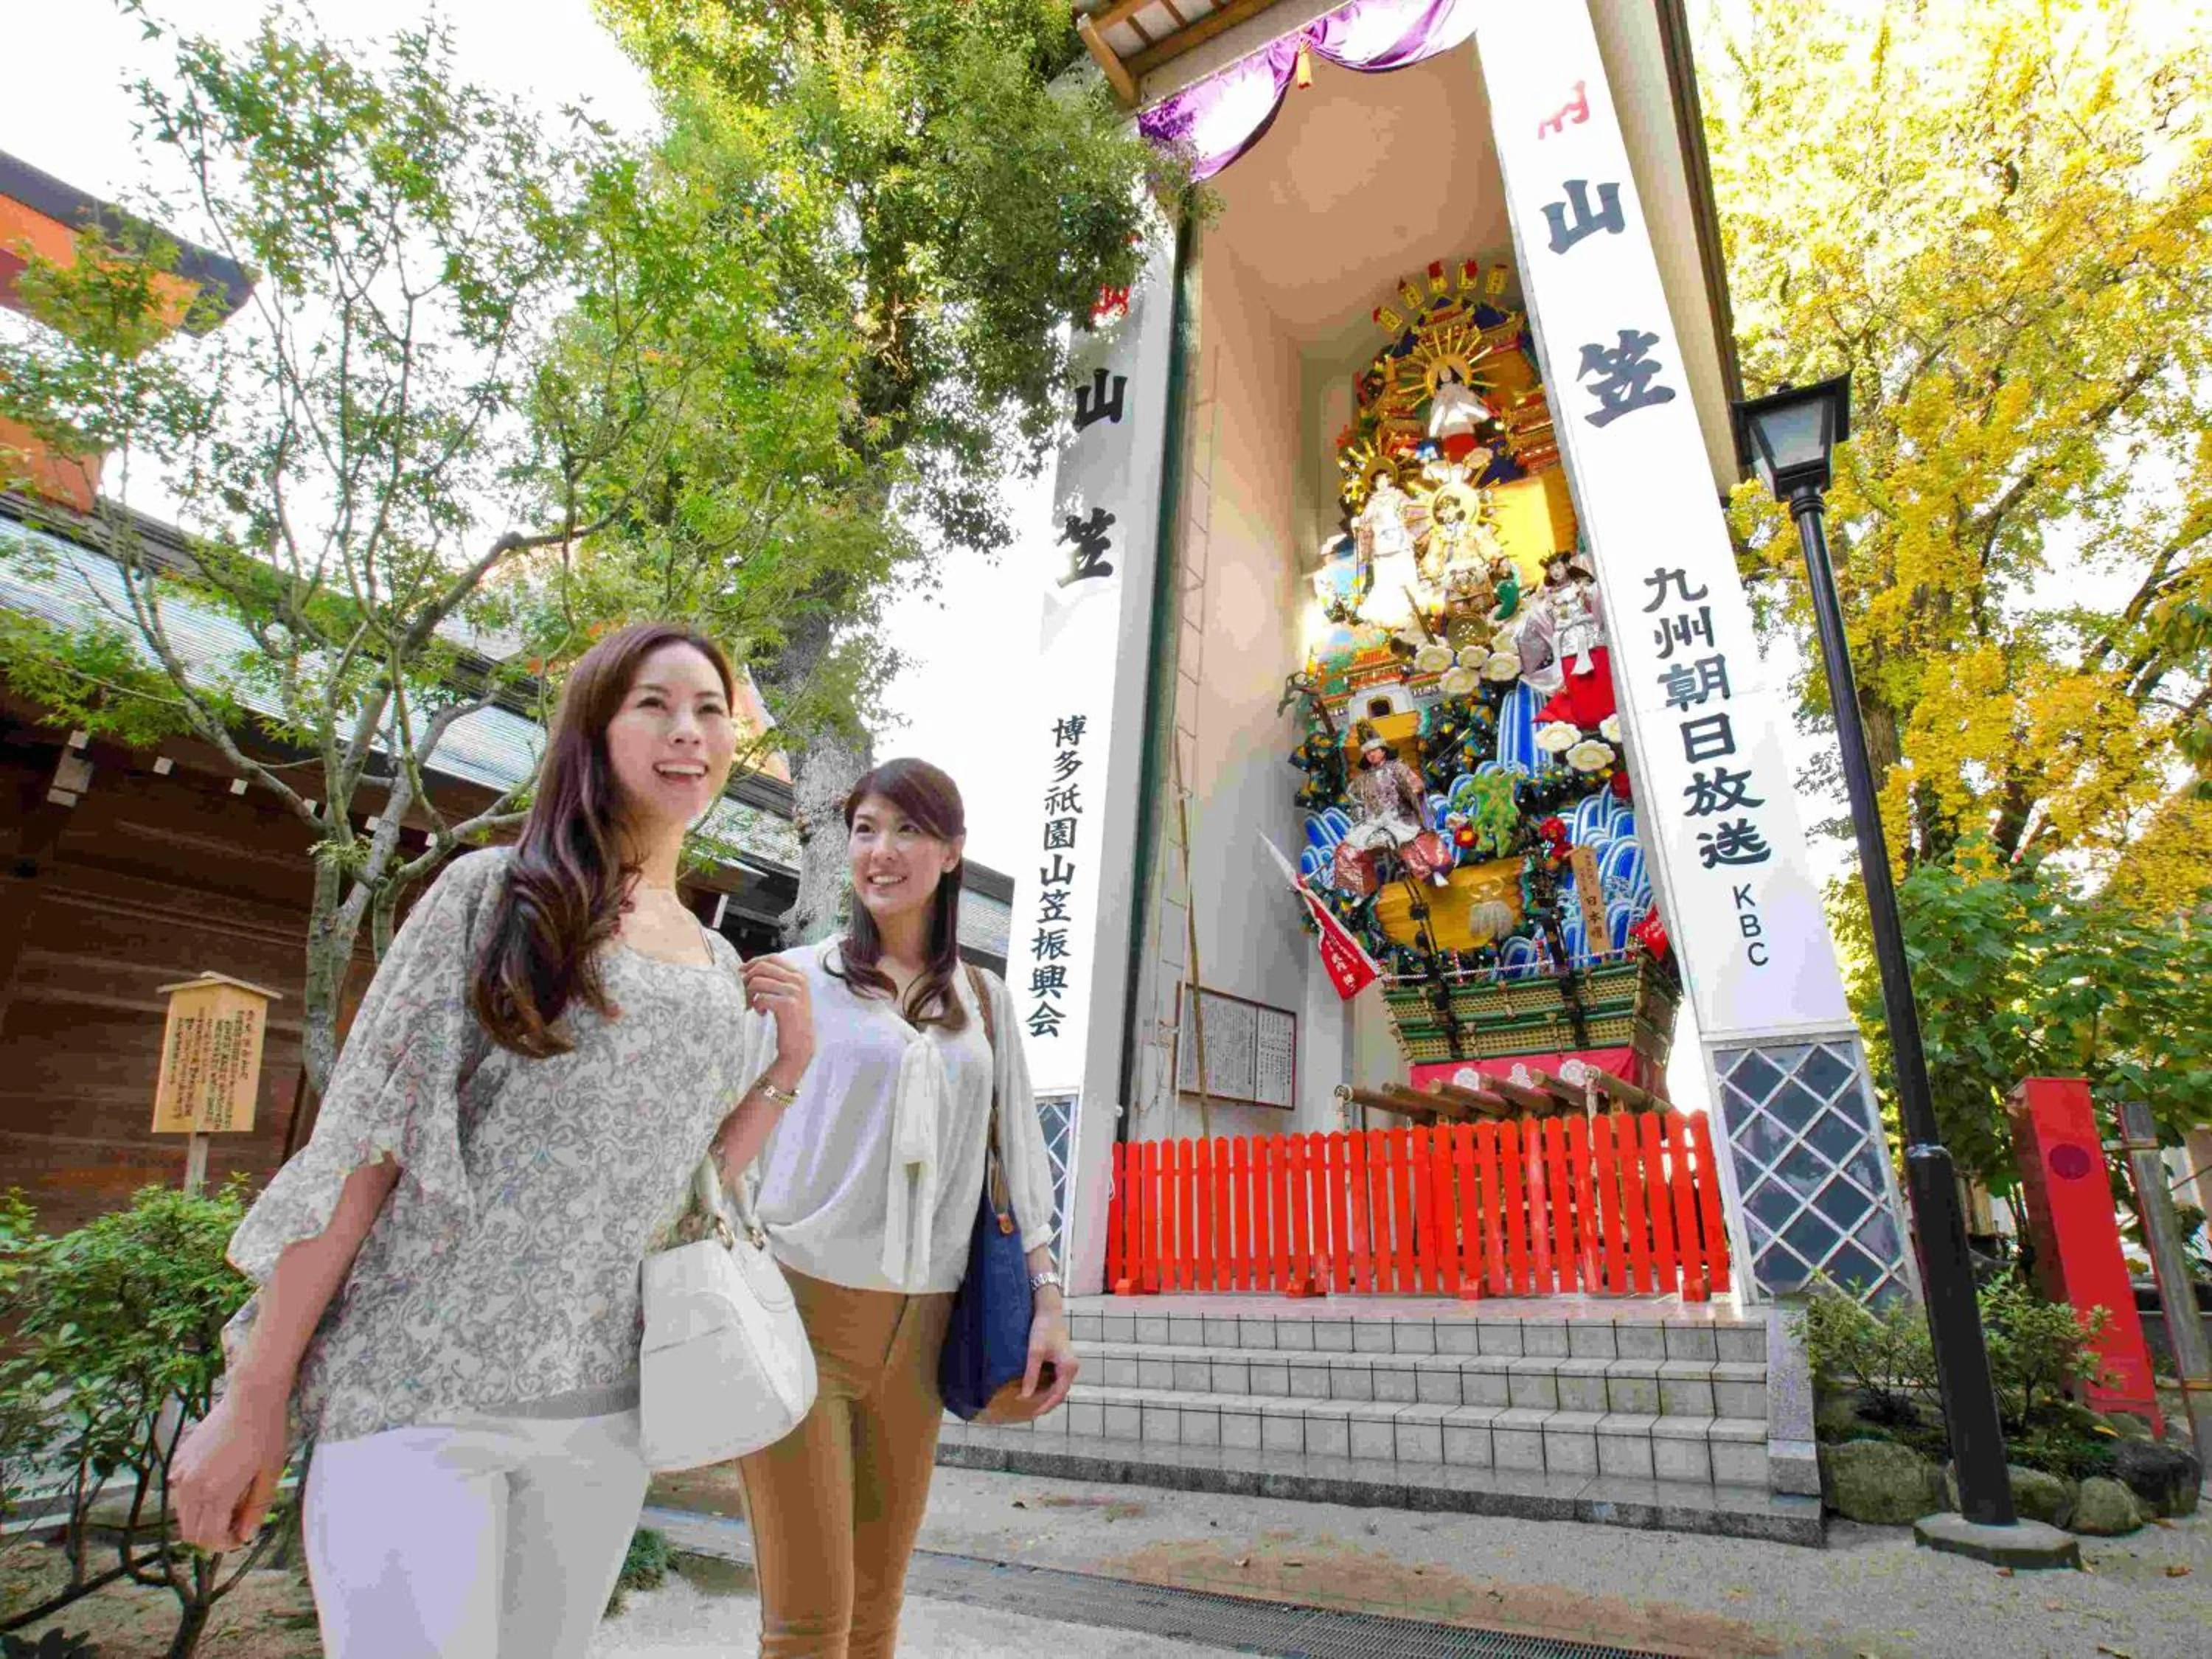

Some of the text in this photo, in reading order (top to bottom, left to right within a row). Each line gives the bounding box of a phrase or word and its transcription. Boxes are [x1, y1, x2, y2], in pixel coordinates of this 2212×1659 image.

[1642, 566, 1772, 869] 九州朝日放送
[1026, 714, 1087, 1037] 博多祇園山笠振興会
[1732, 883, 1769, 967] KBC
